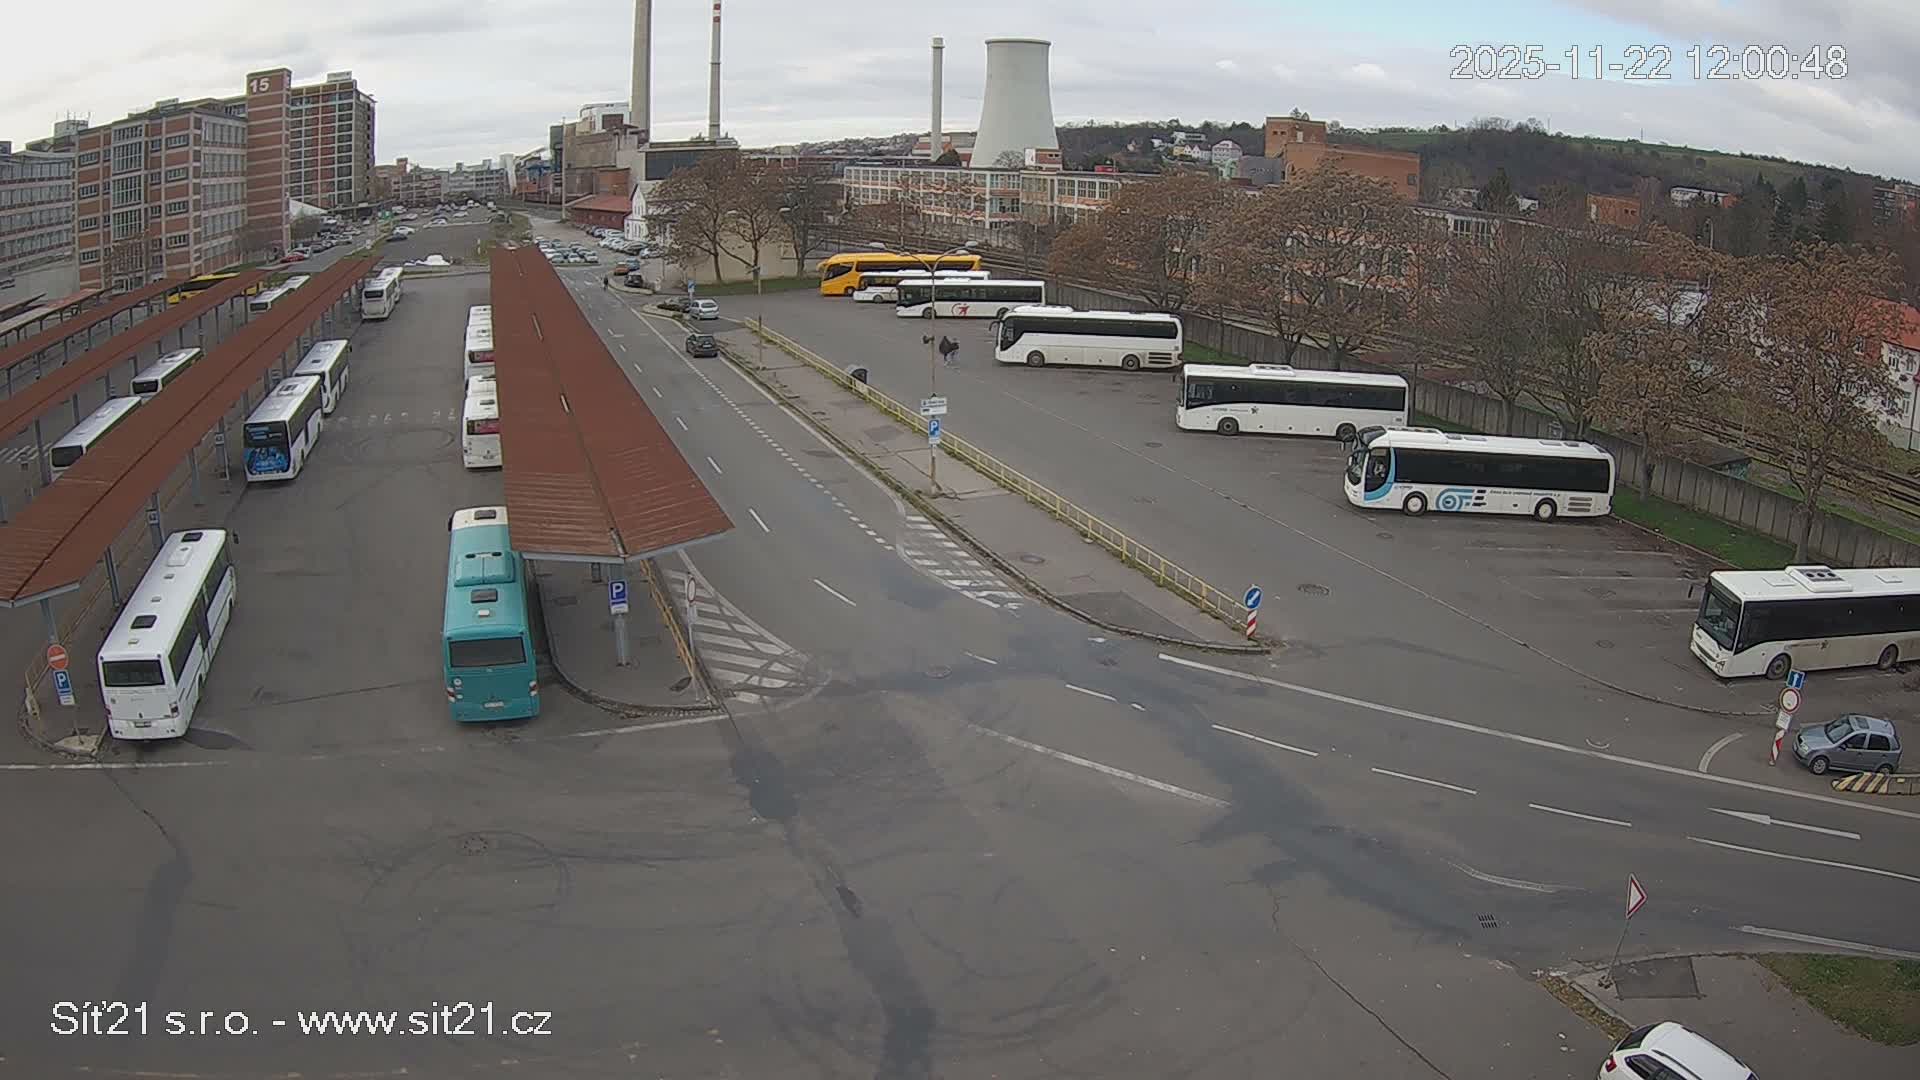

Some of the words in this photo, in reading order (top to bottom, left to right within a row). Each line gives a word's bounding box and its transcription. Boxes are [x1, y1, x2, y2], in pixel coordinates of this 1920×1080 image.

[250, 77, 270, 93] 15
[612, 582, 624, 599] P
[56, 672, 67, 688] P
